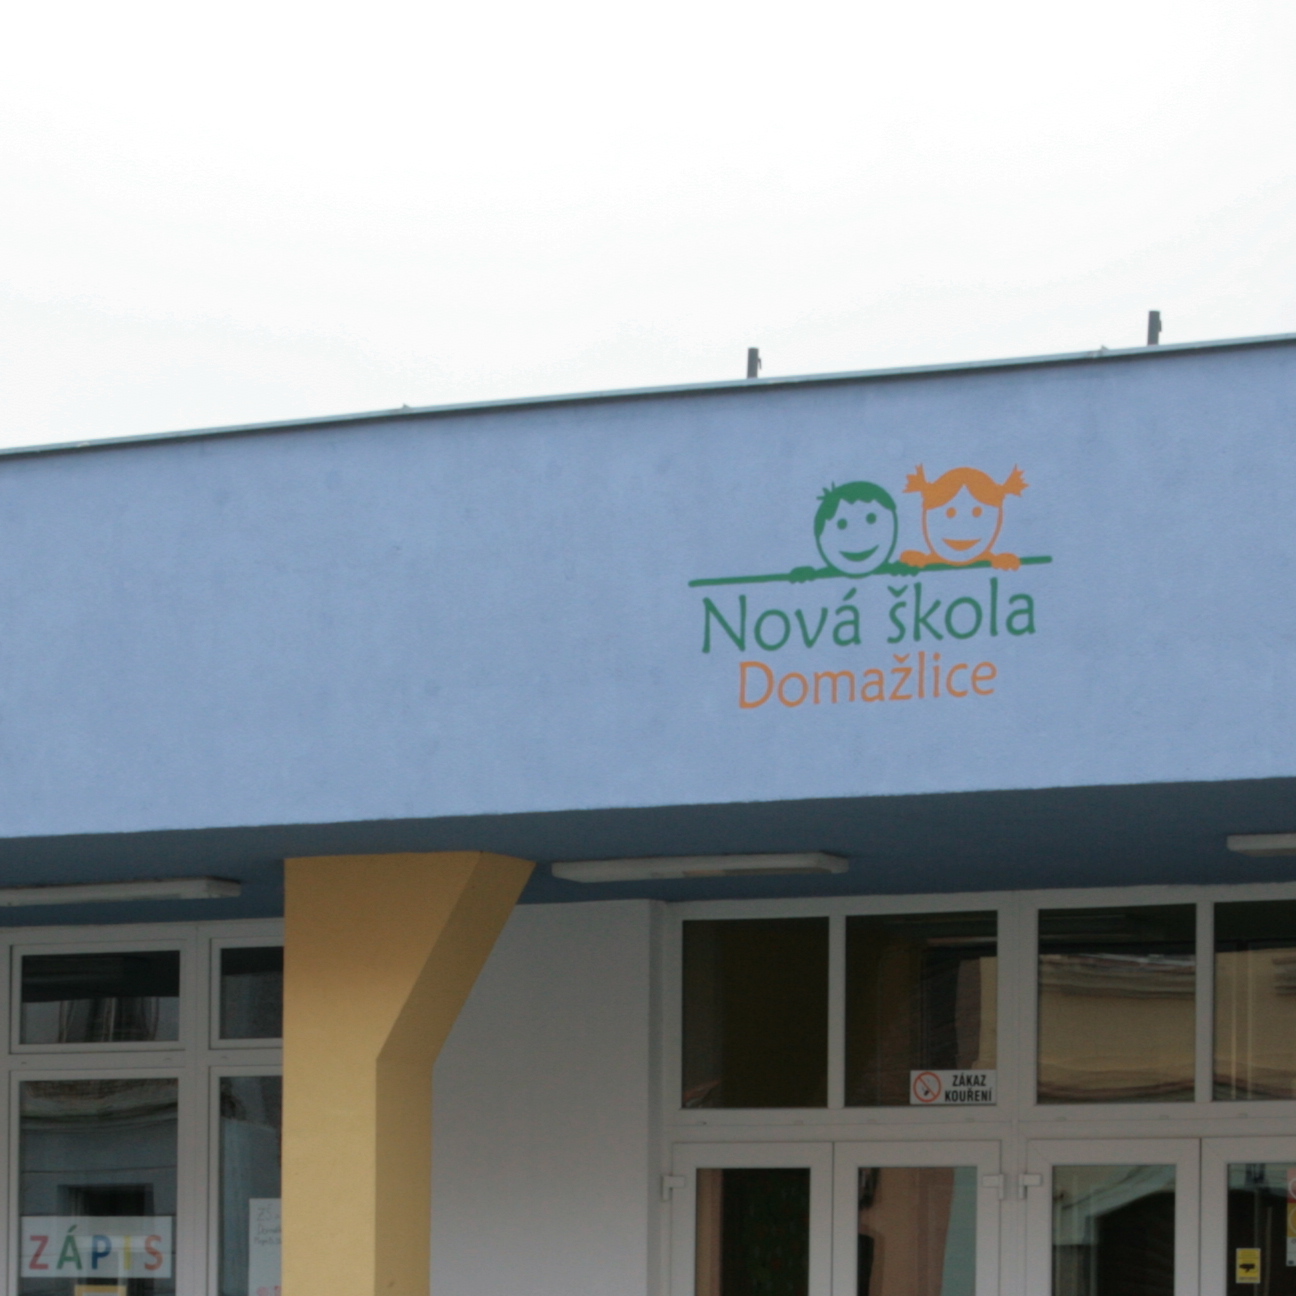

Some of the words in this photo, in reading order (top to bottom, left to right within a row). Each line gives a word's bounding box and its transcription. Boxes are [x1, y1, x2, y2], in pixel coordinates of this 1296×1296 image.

[702, 587, 861, 653] Nová
[887, 577, 1036, 644] škola
[739, 651, 997, 708] Domažlice
[945, 1087, 992, 1102] KOUŘENÍ
[952, 1073, 987, 1087] ZÁKAZ
[29, 1224, 163, 1271] ZÁPIS
